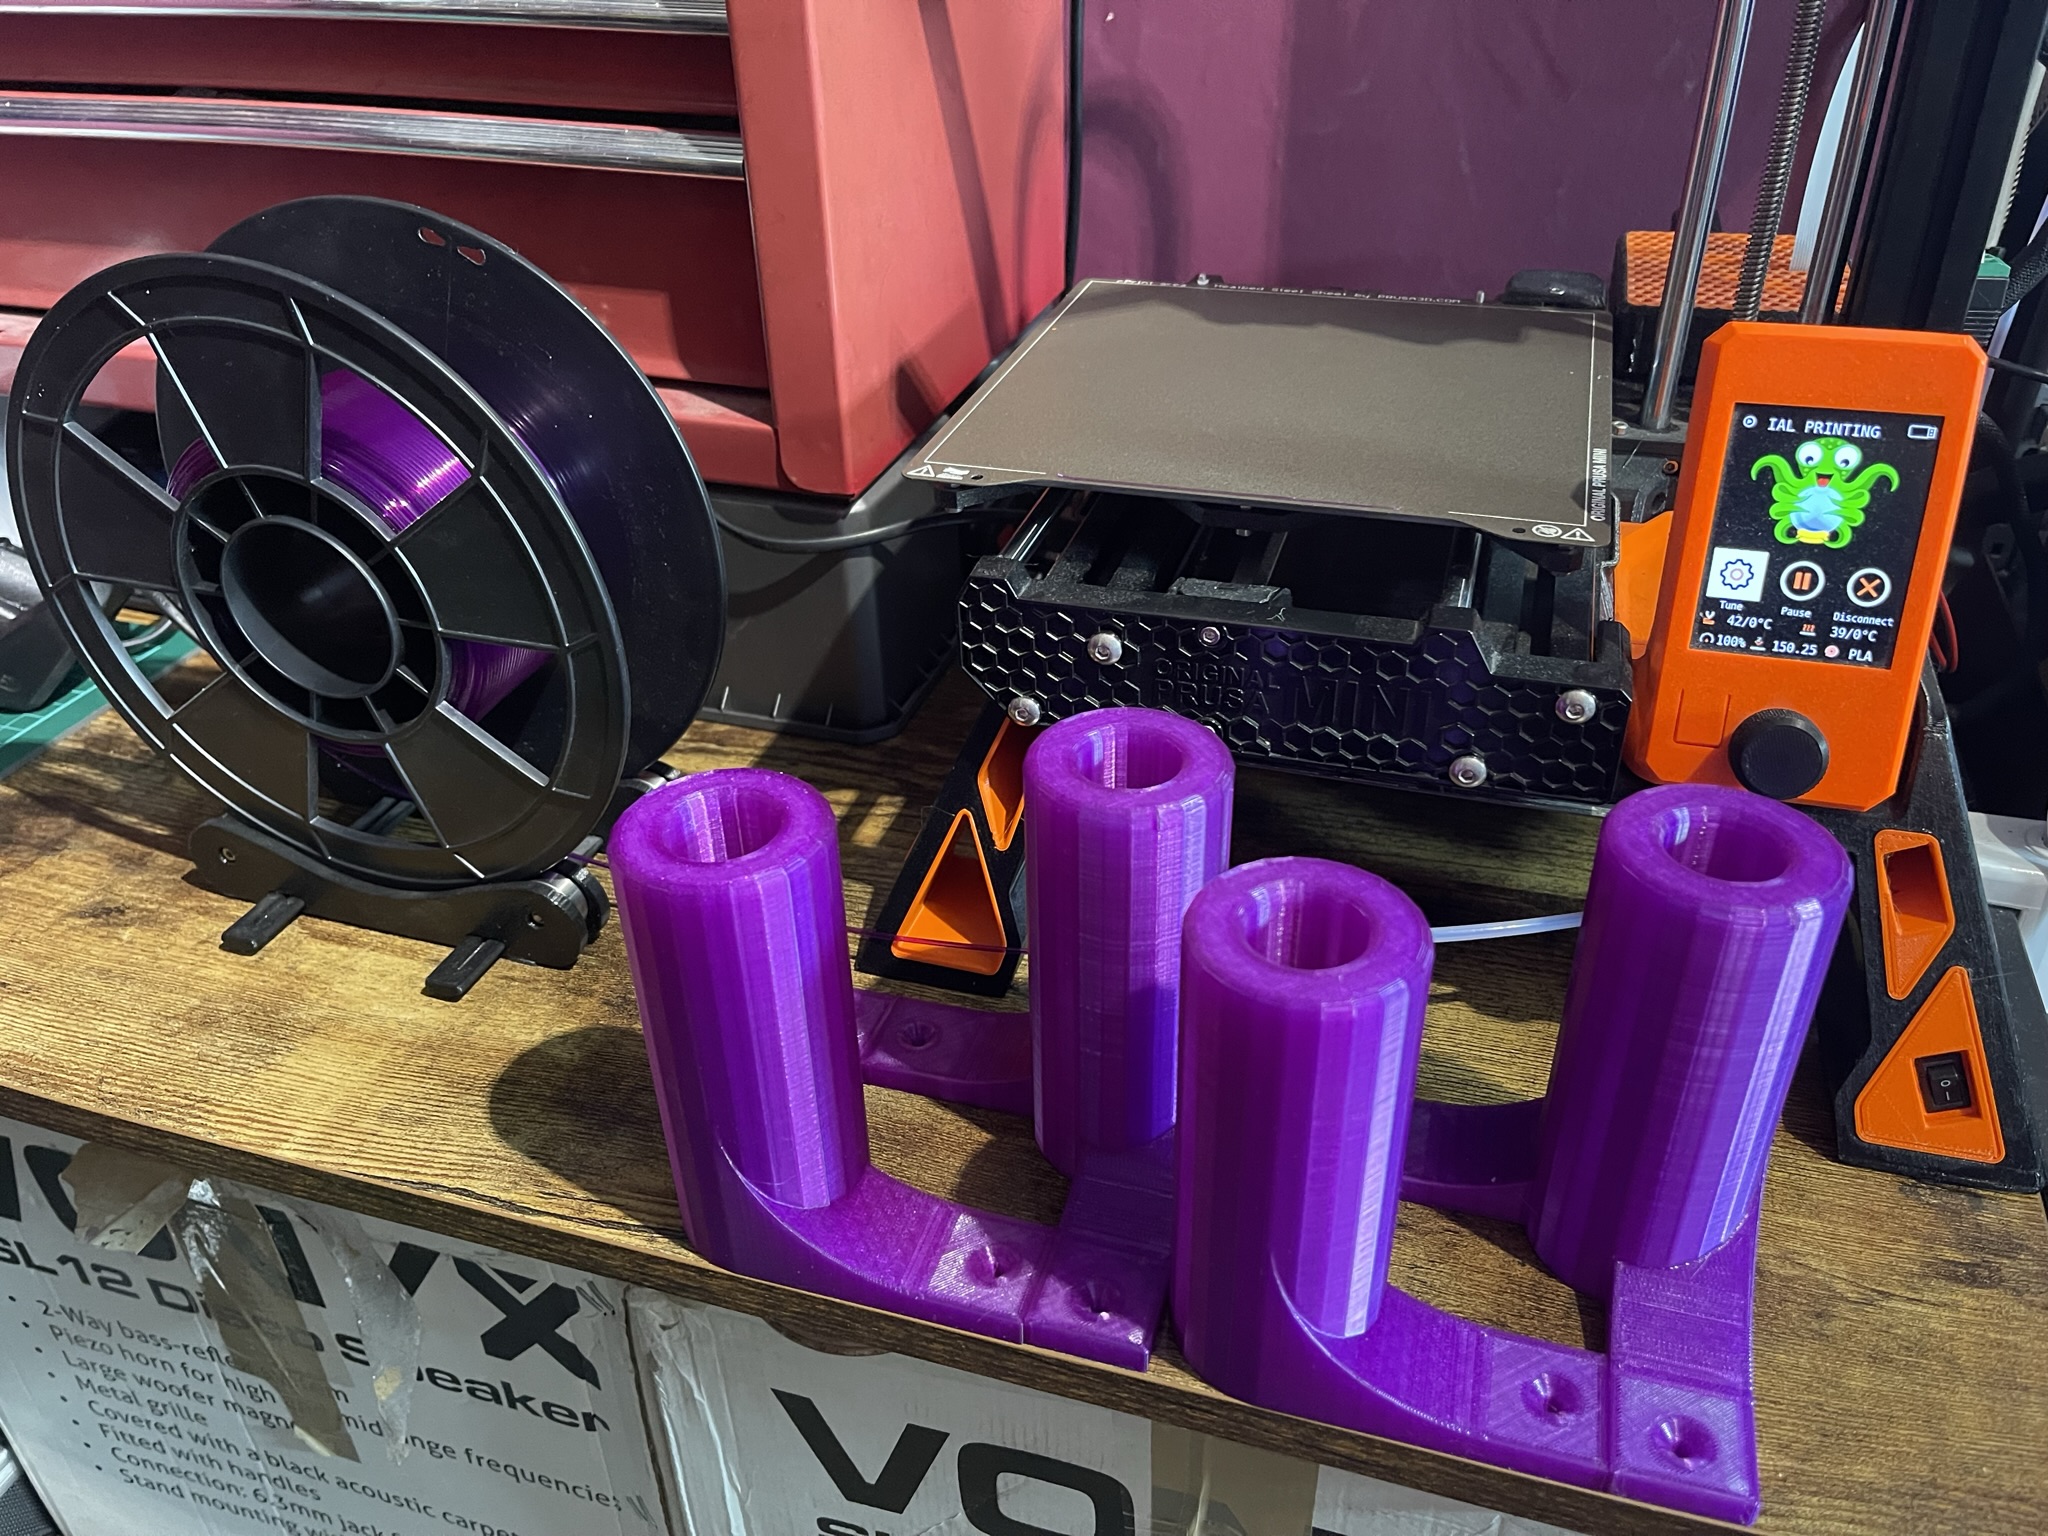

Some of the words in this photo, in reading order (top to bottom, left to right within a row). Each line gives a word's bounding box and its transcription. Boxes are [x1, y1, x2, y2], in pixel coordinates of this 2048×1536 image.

[1767, 417, 1796, 433] IAL
[1804, 421, 1882, 439] PRINTING
[1592, 447, 1608, 464] MINI
[1592, 464, 1608, 487] PRUSA
[1590, 488, 1607, 522] ORIGINAL
[1719, 600, 1744, 611] Tune
[1780, 606, 1812, 619] Pause
[1832, 611, 1894, 627] Disconnect
[1726, 615, 1773, 630] 42/0°C
[1829, 626, 1878, 643] 39/0°C
[1155, 657, 1281, 690] ORIGINAL
[1716, 633, 1747, 648] 100%
[1772, 640, 1818, 656] 150.25
[1848, 648, 1873, 662] PLA
[1155, 678, 1270, 716] PRUSA
[1292, 673, 1434, 740] MINI
[35, 1299, 112, 1337] 2-Way
[116, 1319, 235, 1369] bass-refle
[49, 1324, 114, 1356] Piezo
[117, 1343, 176, 1375] horn
[180, 1361, 215, 1385] for
[221, 1372, 277, 1404] high
[62, 1350, 128, 1383] Large
[132, 1372, 215, 1407] woofer
[224, 1399, 296, 1430] magn
[335, 1332, 611, 1433] Seaker
[75, 1375, 143, 1407] Metal
[147, 1398, 209, 1428] grille
[88, 1400, 183, 1440] Covered
[187, 1430, 241, 1457] with
[245, 1447, 261, 1462] a
[264, 1450, 330, 1485] black
[335, 1476, 437, 1518] acoustic
[98, 1422, 167, 1456] Fitted
[170, 1446, 223, 1472] with
[227, 1459, 321, 1502] handles
[111, 1446, 248, 1499] Connection:
[119, 1468, 185, 1500] Stand
[190, 1490, 302, 1536] mounting
